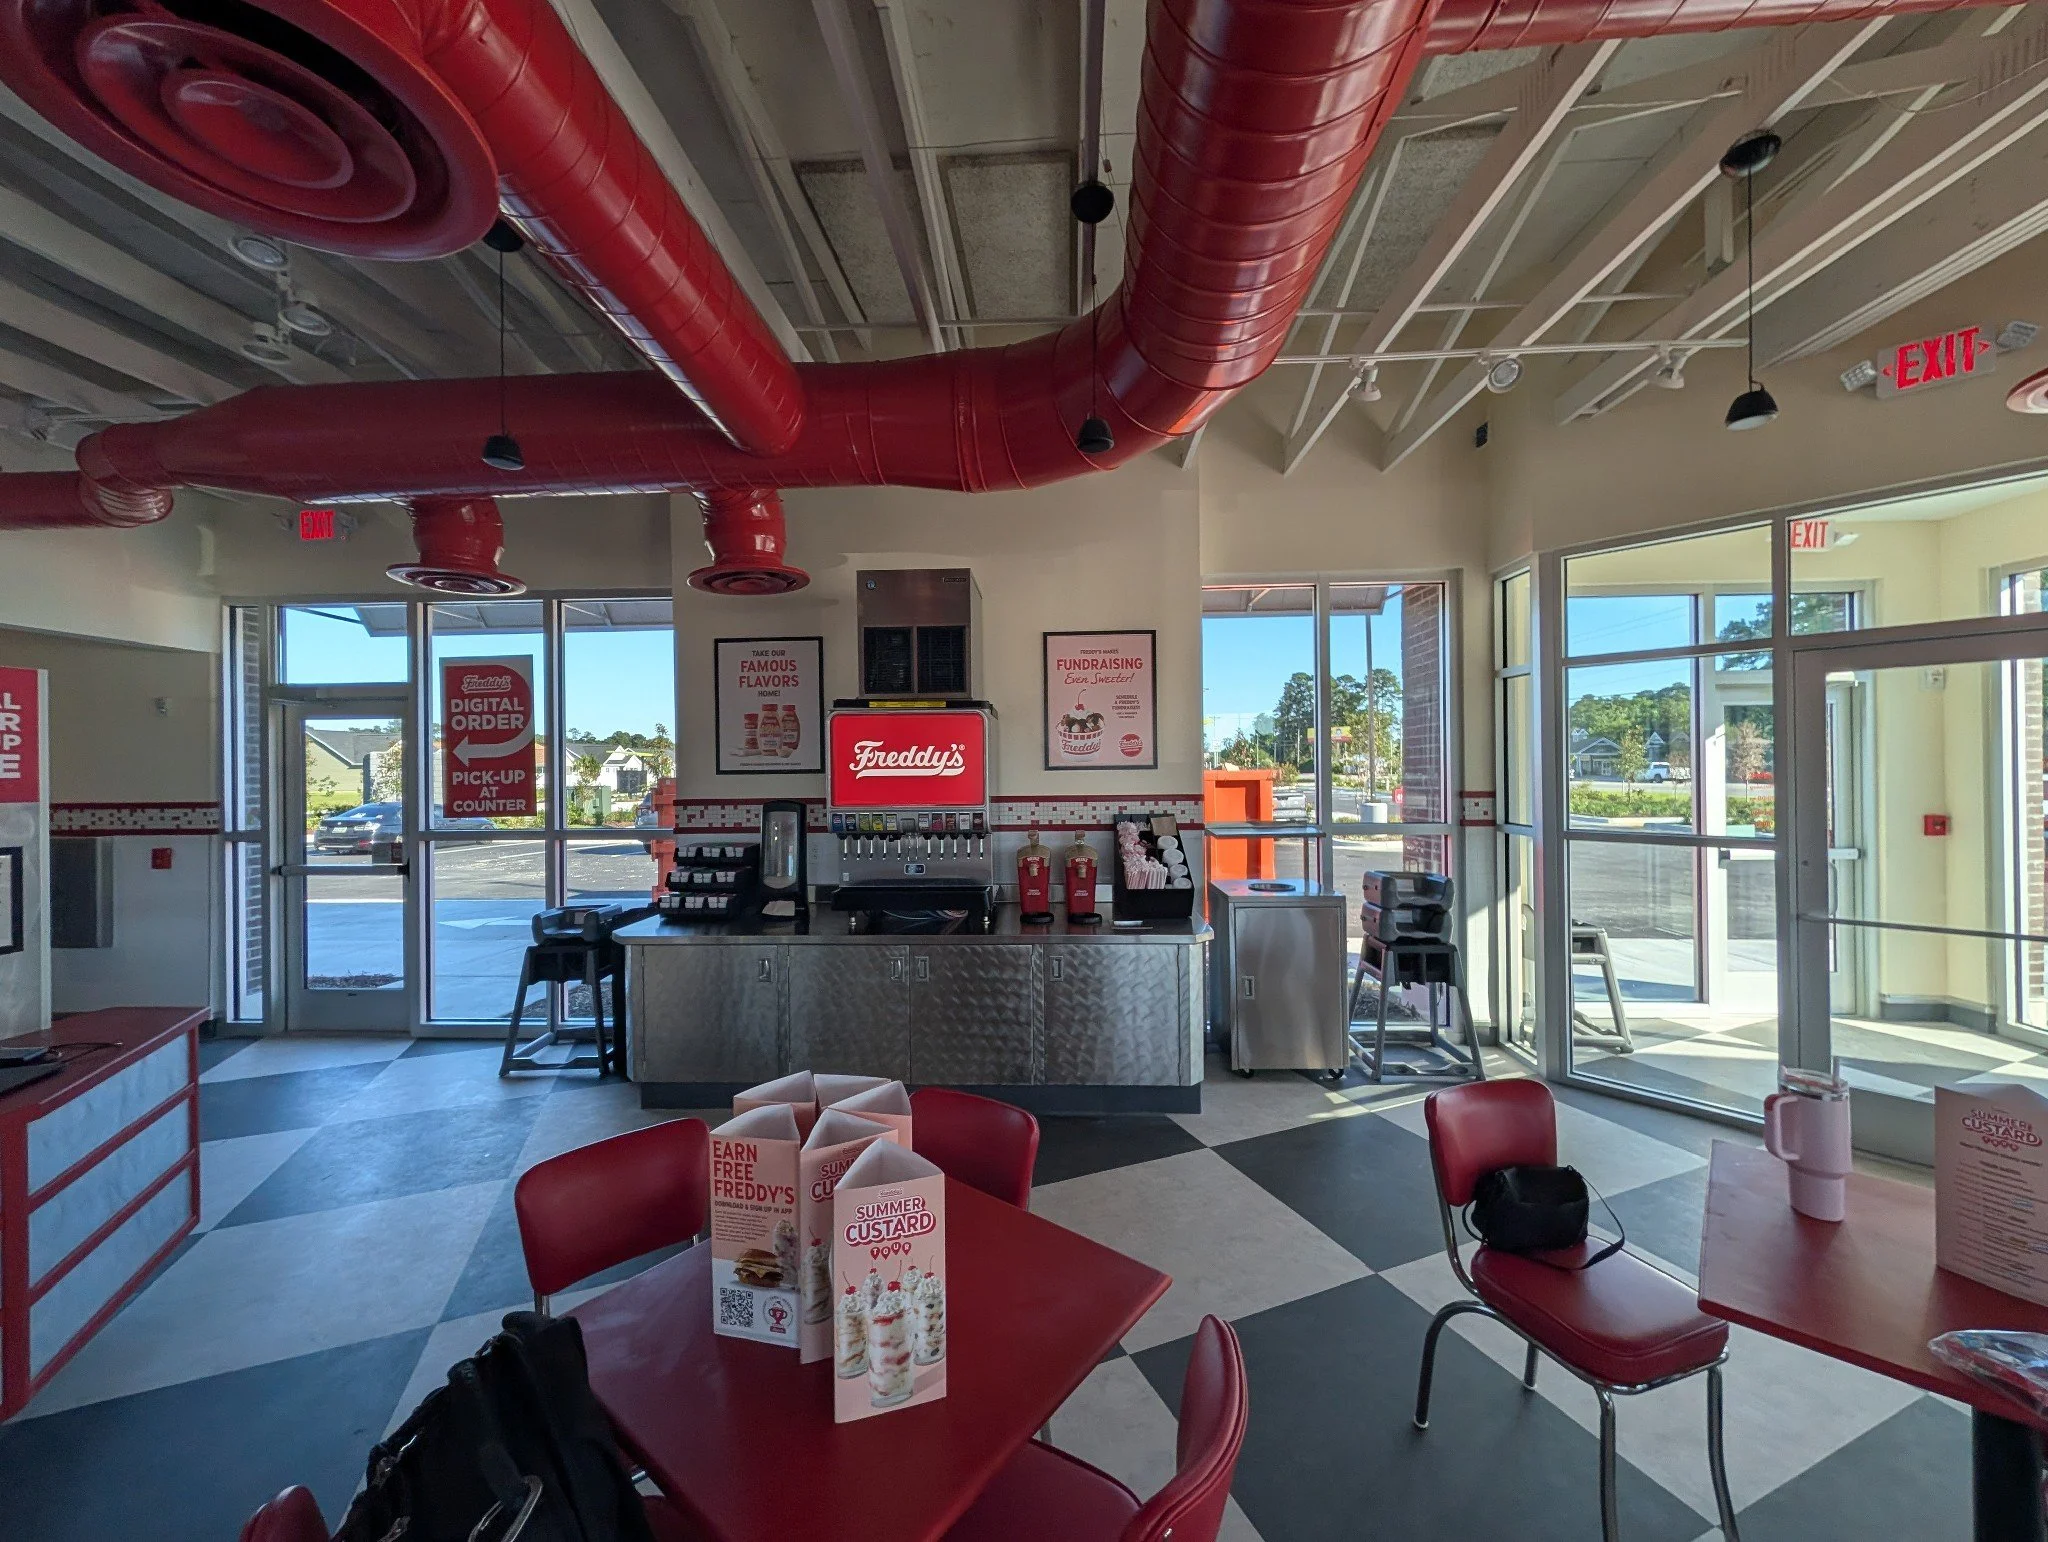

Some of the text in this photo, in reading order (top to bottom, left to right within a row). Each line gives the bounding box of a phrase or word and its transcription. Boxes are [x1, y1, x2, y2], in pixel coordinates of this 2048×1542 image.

[1895, 327, 1980, 390] EXIT
[300, 510, 334, 539] EXIT
[1791, 520, 1829, 548] EXIT
[740, 659, 797, 673] FAMOUS
[1056, 657, 1143, 671] FUNDRAISING
[462, 675, 511, 692] Freddy's
[738, 674, 799, 688] FLAVORS
[1064, 672, 1089, 685] Even
[450, 697, 525, 713] DIGITAL
[451, 714, 525, 731] ORDER
[452, 770, 526, 786] PICK-UP
[479, 786, 499, 799] AT
[453, 799, 527, 813] COUNTER
[1970, 1109, 2028, 1129] SUMMER
[1961, 1117, 2038, 1143] CUSTARD
[713, 1140, 758, 1162] EARN
[713, 1160, 754, 1181] FREE
[821, 1159, 857, 1176] SUM
[714, 1179, 795, 1205] FREDDY'S
[714, 1200, 744, 1210] DOWNLOAD
[856, 1197, 923, 1220] SUMMER
[845, 1212, 934, 1243] CUSTARD
[871, 1242, 911, 1255] TOUR
